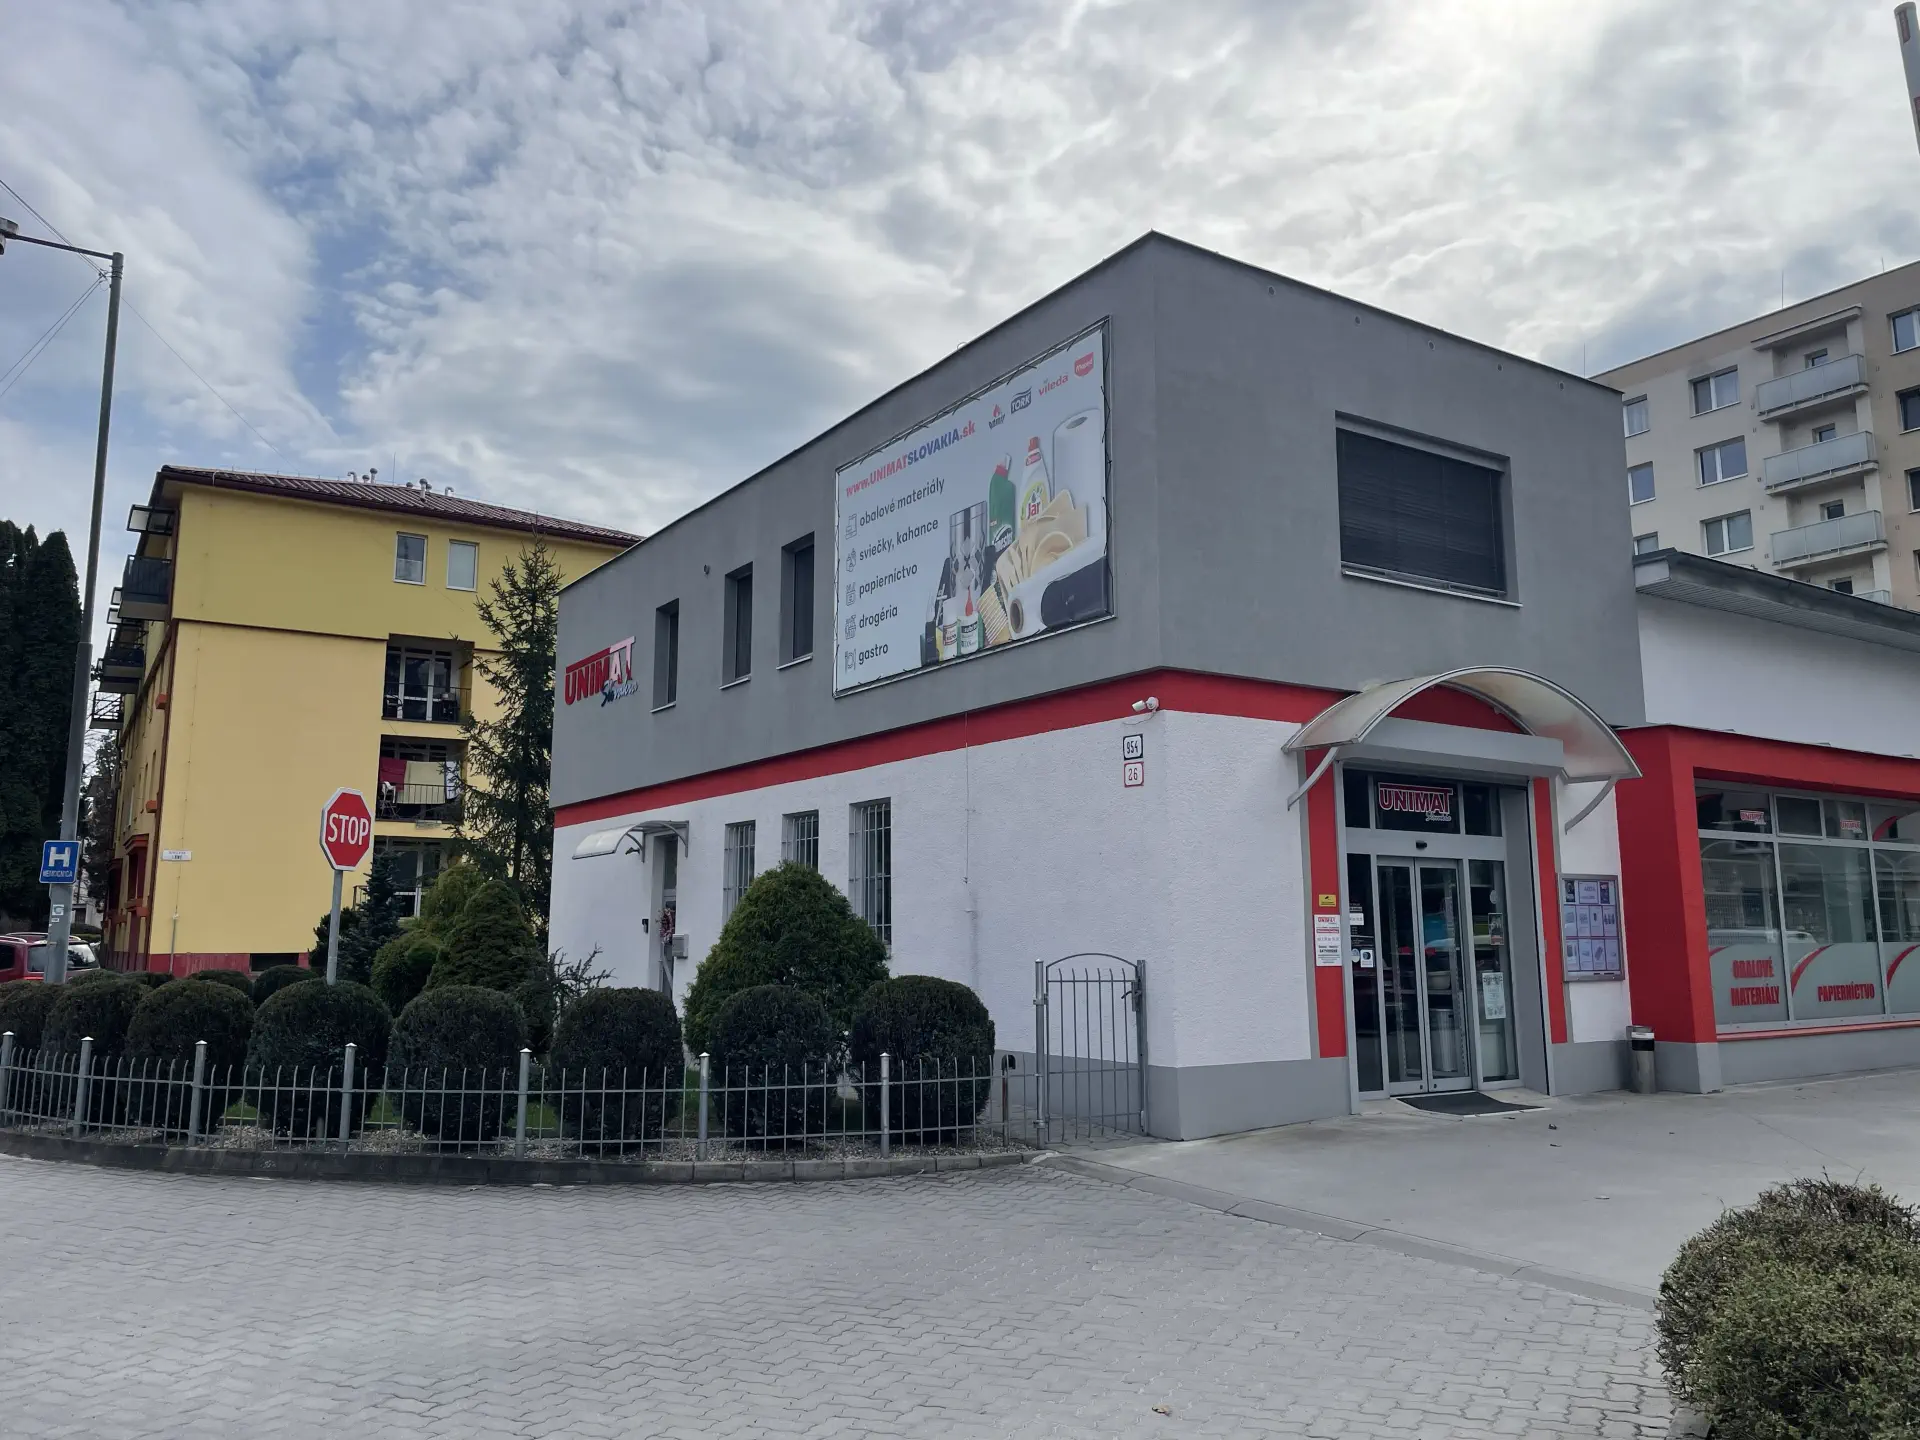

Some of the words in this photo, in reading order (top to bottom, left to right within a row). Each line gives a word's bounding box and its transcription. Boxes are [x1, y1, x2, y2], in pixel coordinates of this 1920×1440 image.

[1039, 375, 1068, 396] vileda
[1011, 394, 1031, 412] TORK
[846, 420, 976, 497] www.UNIMATSLOVAKIA.sk
[860, 499, 895, 526] obalové
[897, 477, 945, 509] materiály
[1027, 501, 1041, 519] Jar
[859, 538, 895, 560] sviečky,
[897, 519, 938, 545] kahance
[859, 604, 898, 629] drogéria
[858, 643, 889, 665] gastro
[564, 636, 636, 705] UNIMAT
[1127, 741, 1138, 754] 954
[1128, 768, 1138, 780] 26
[1378, 782, 1453, 814] UNIMAT
[328, 813, 369, 845] STOP
[48, 846, 71, 867] H
[1731, 983, 1780, 1007] MATERIÁLY
[1817, 981, 1875, 1002] PAPIERNÍCTVO
